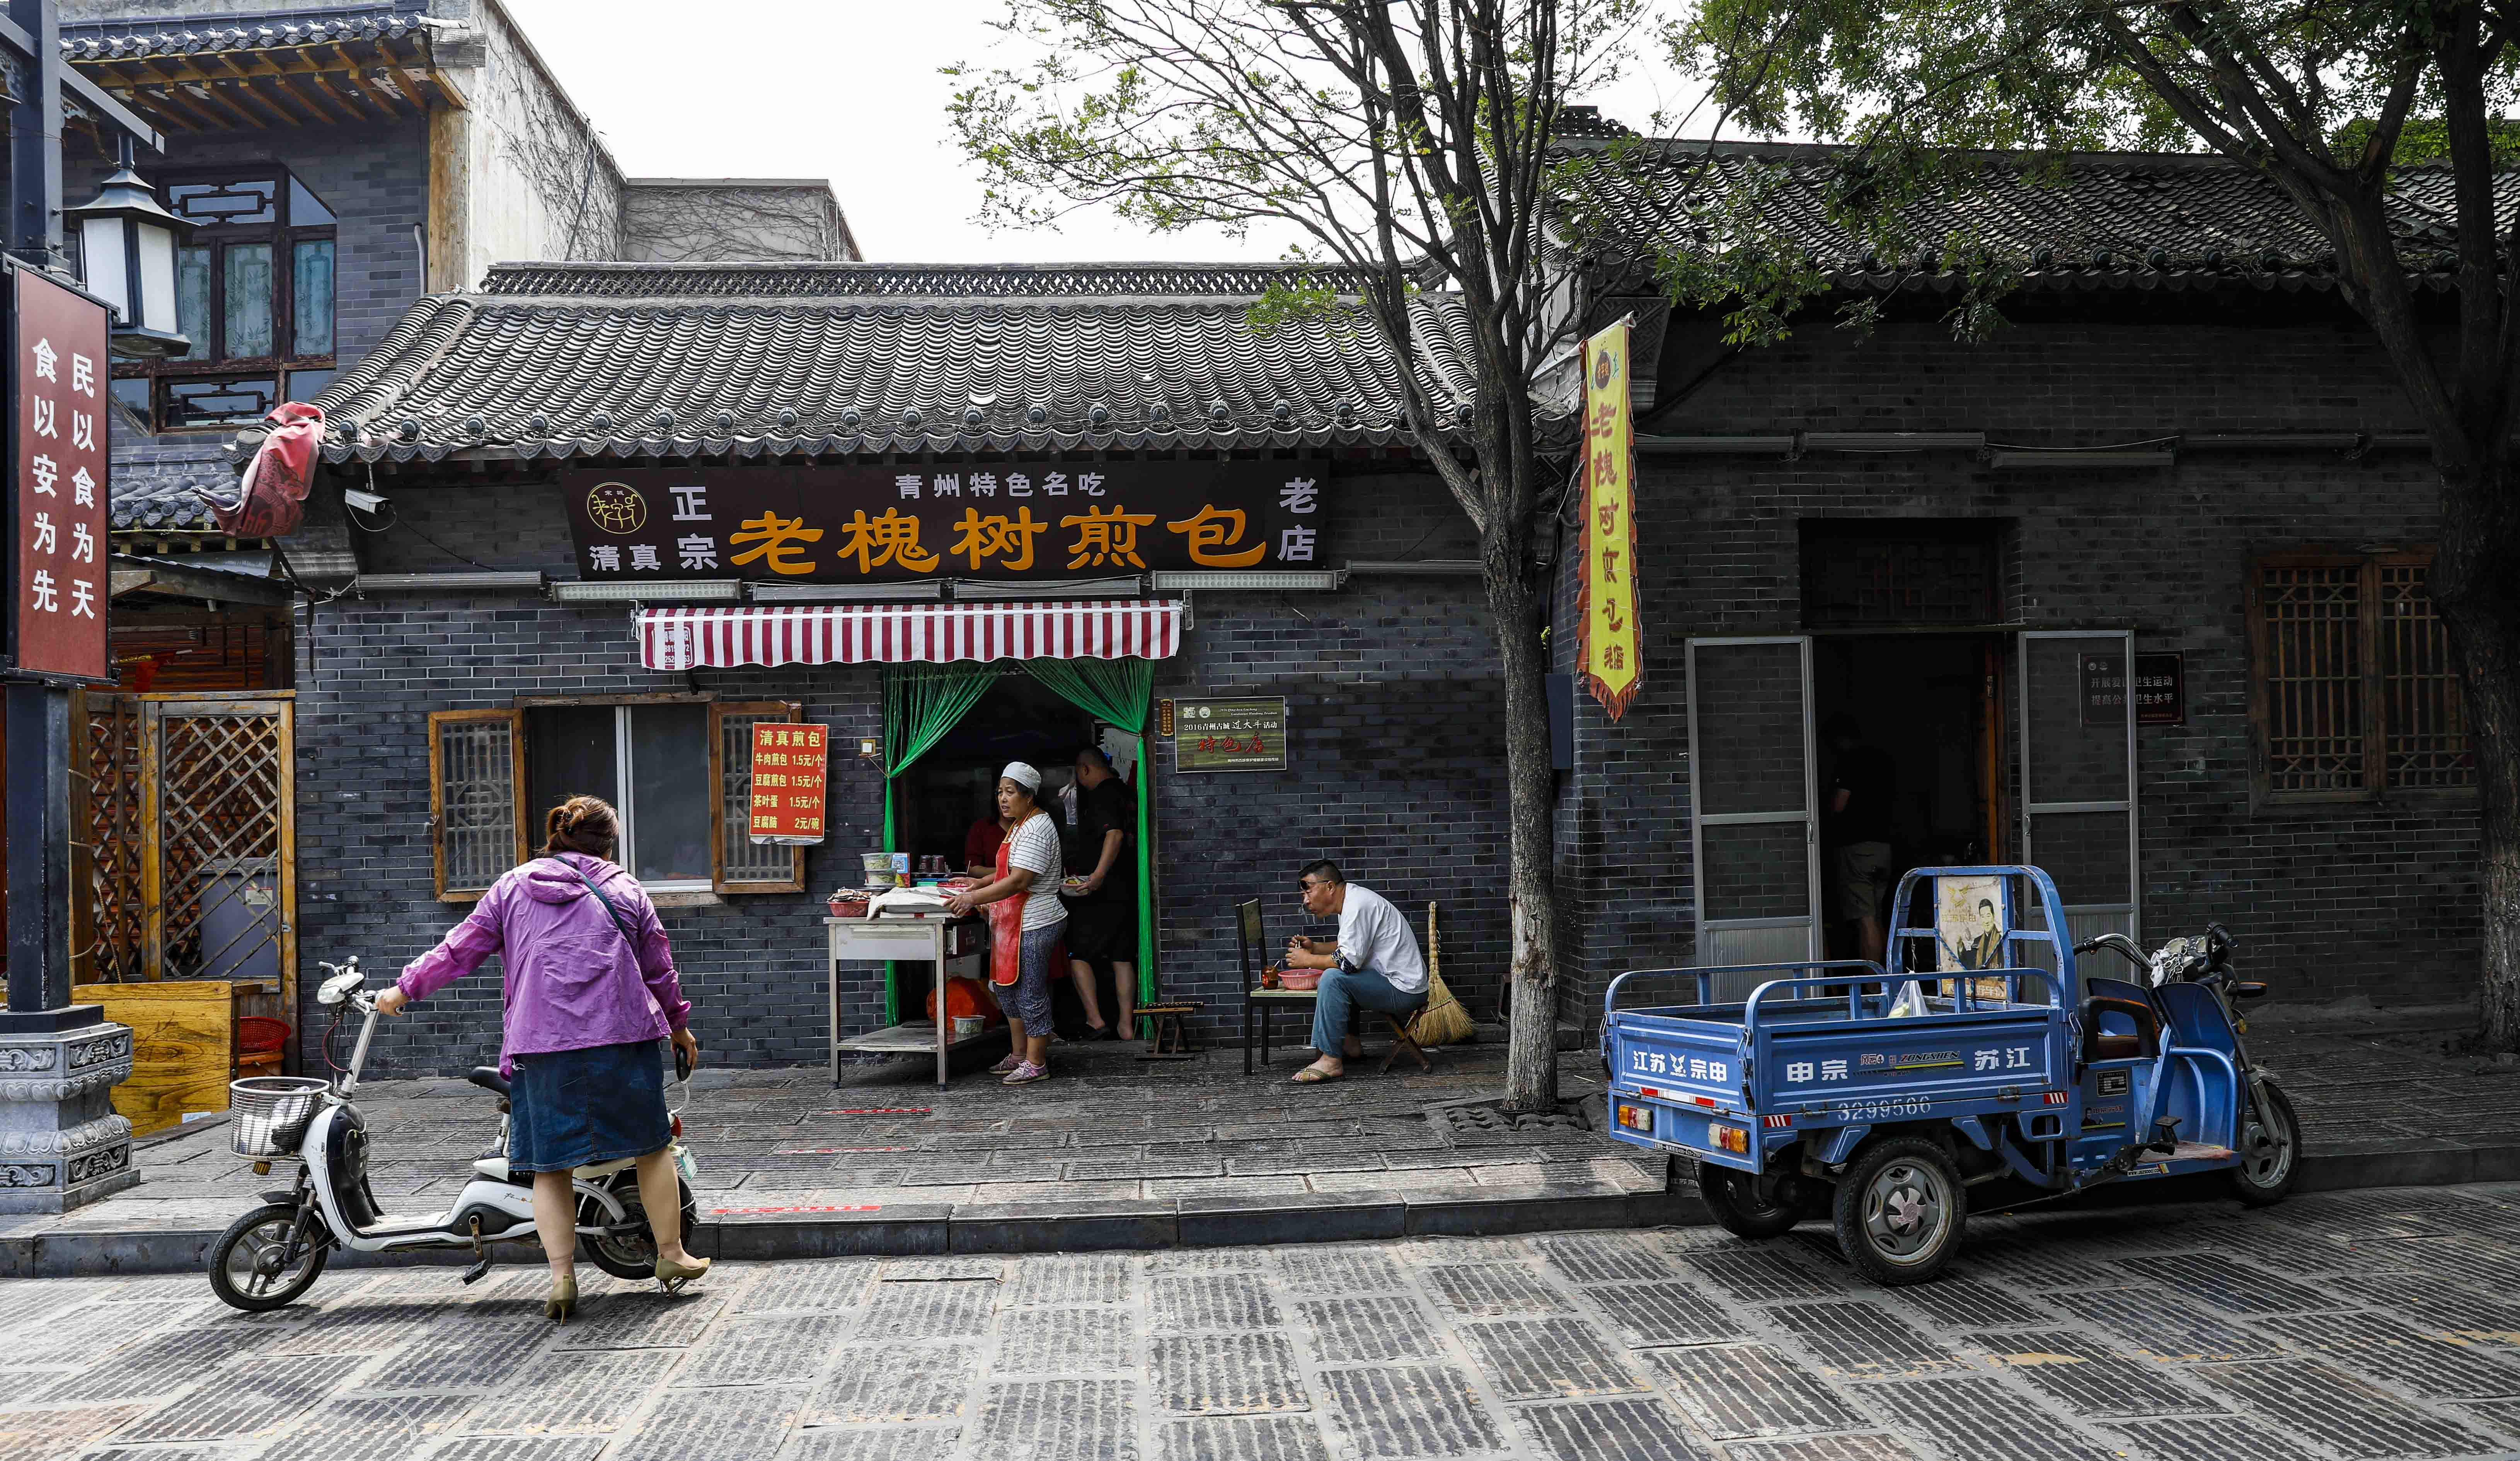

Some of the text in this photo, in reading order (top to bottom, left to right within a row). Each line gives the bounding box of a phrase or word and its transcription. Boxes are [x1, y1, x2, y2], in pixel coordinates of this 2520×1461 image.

[32, 337, 58, 613] 食以安为先
[72, 352, 95, 619] 民以食为天
[895, 471, 1106, 500] 青州特色名吃
[669, 486, 719, 571] 正宗
[1278, 477, 1318, 562] 老店
[729, 503, 1266, 575] 老槐树煎包
[588, 544, 661, 571] 清真
[760, 730, 821, 747] 清真煎包
[755, 753, 823, 767] 牛肉煎包 1.5元/个
[754, 774, 822, 788] 豆腐煎包 1.5元/个
[754, 794, 820, 809] 茶叶蛋 1.5元/个
[753, 816, 820, 830] 豆腐脑 2元/碗
[1633, 1050, 1728, 1083] 江苏 宗申
[1898, 1050, 1960, 1063] ZONGSHEN
[1838, 1096, 1930, 1121] 3299566
